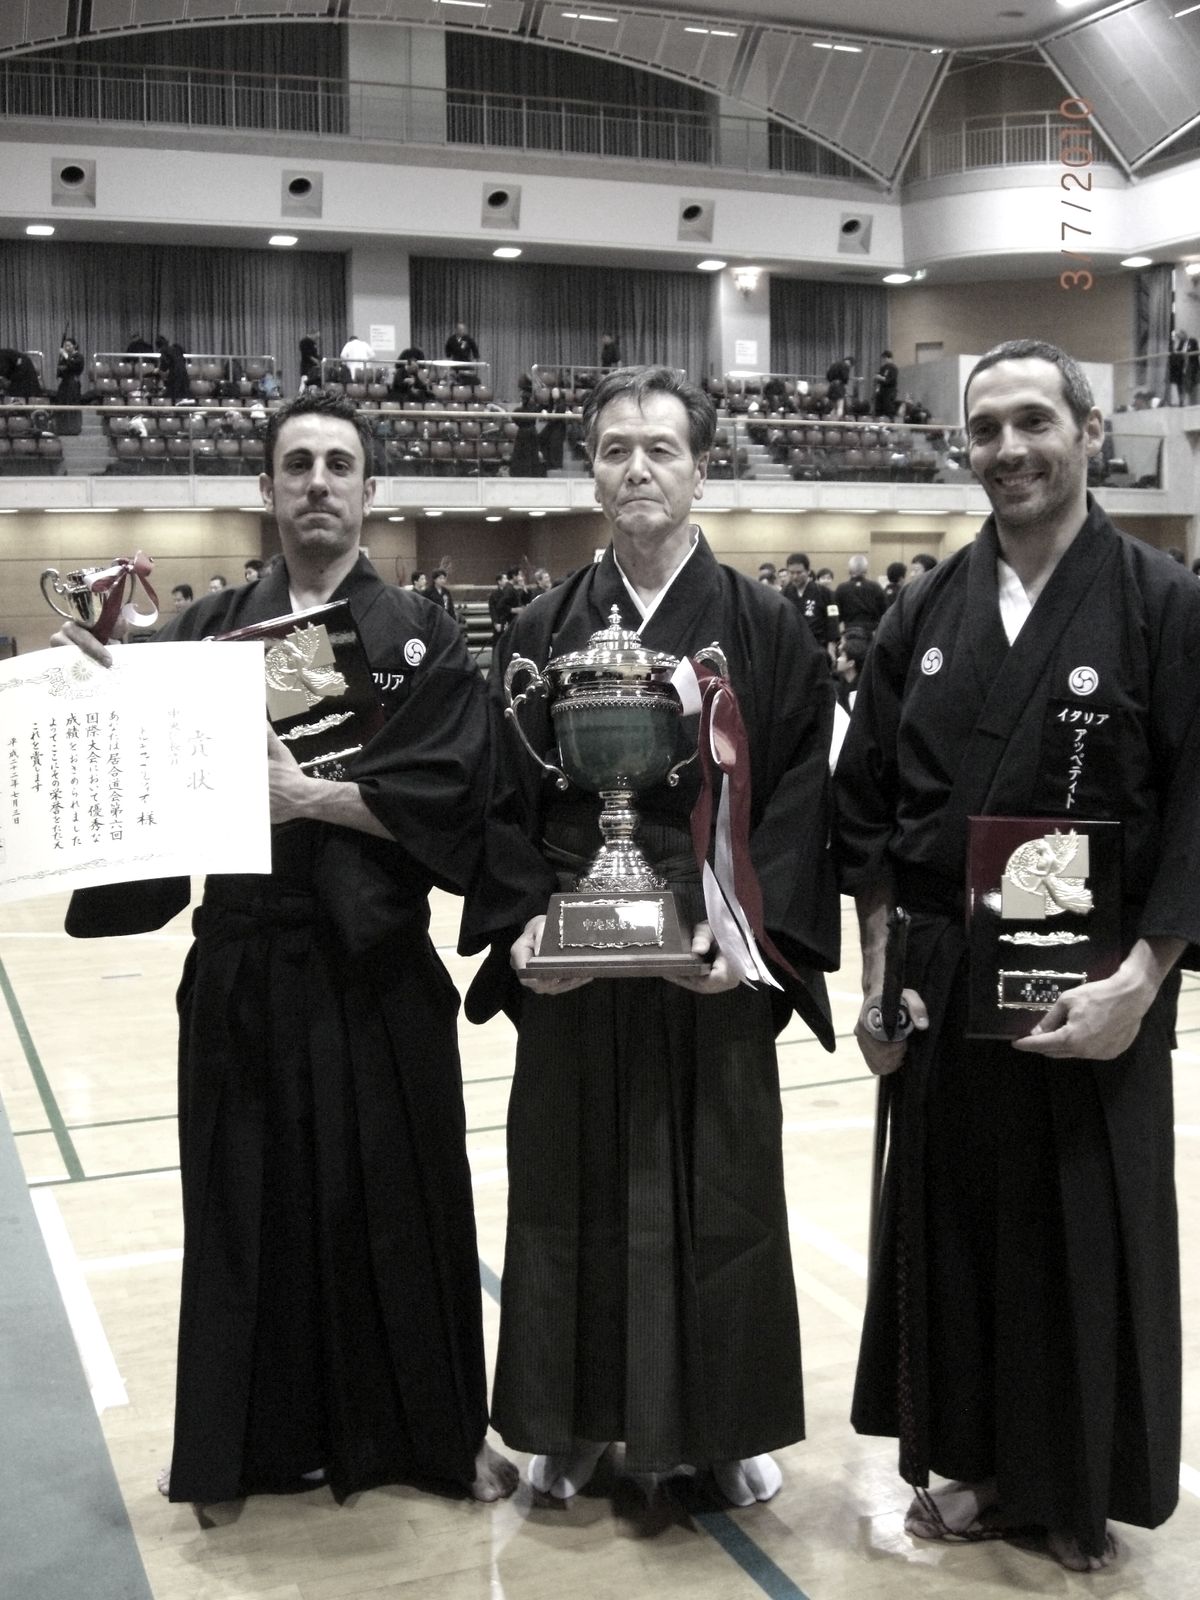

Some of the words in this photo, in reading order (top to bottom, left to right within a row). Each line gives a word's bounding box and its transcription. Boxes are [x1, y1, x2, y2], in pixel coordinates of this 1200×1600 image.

[1057, 708, 1109, 725] イタリア
[86, 711, 105, 843] 国際大会において優秀な
